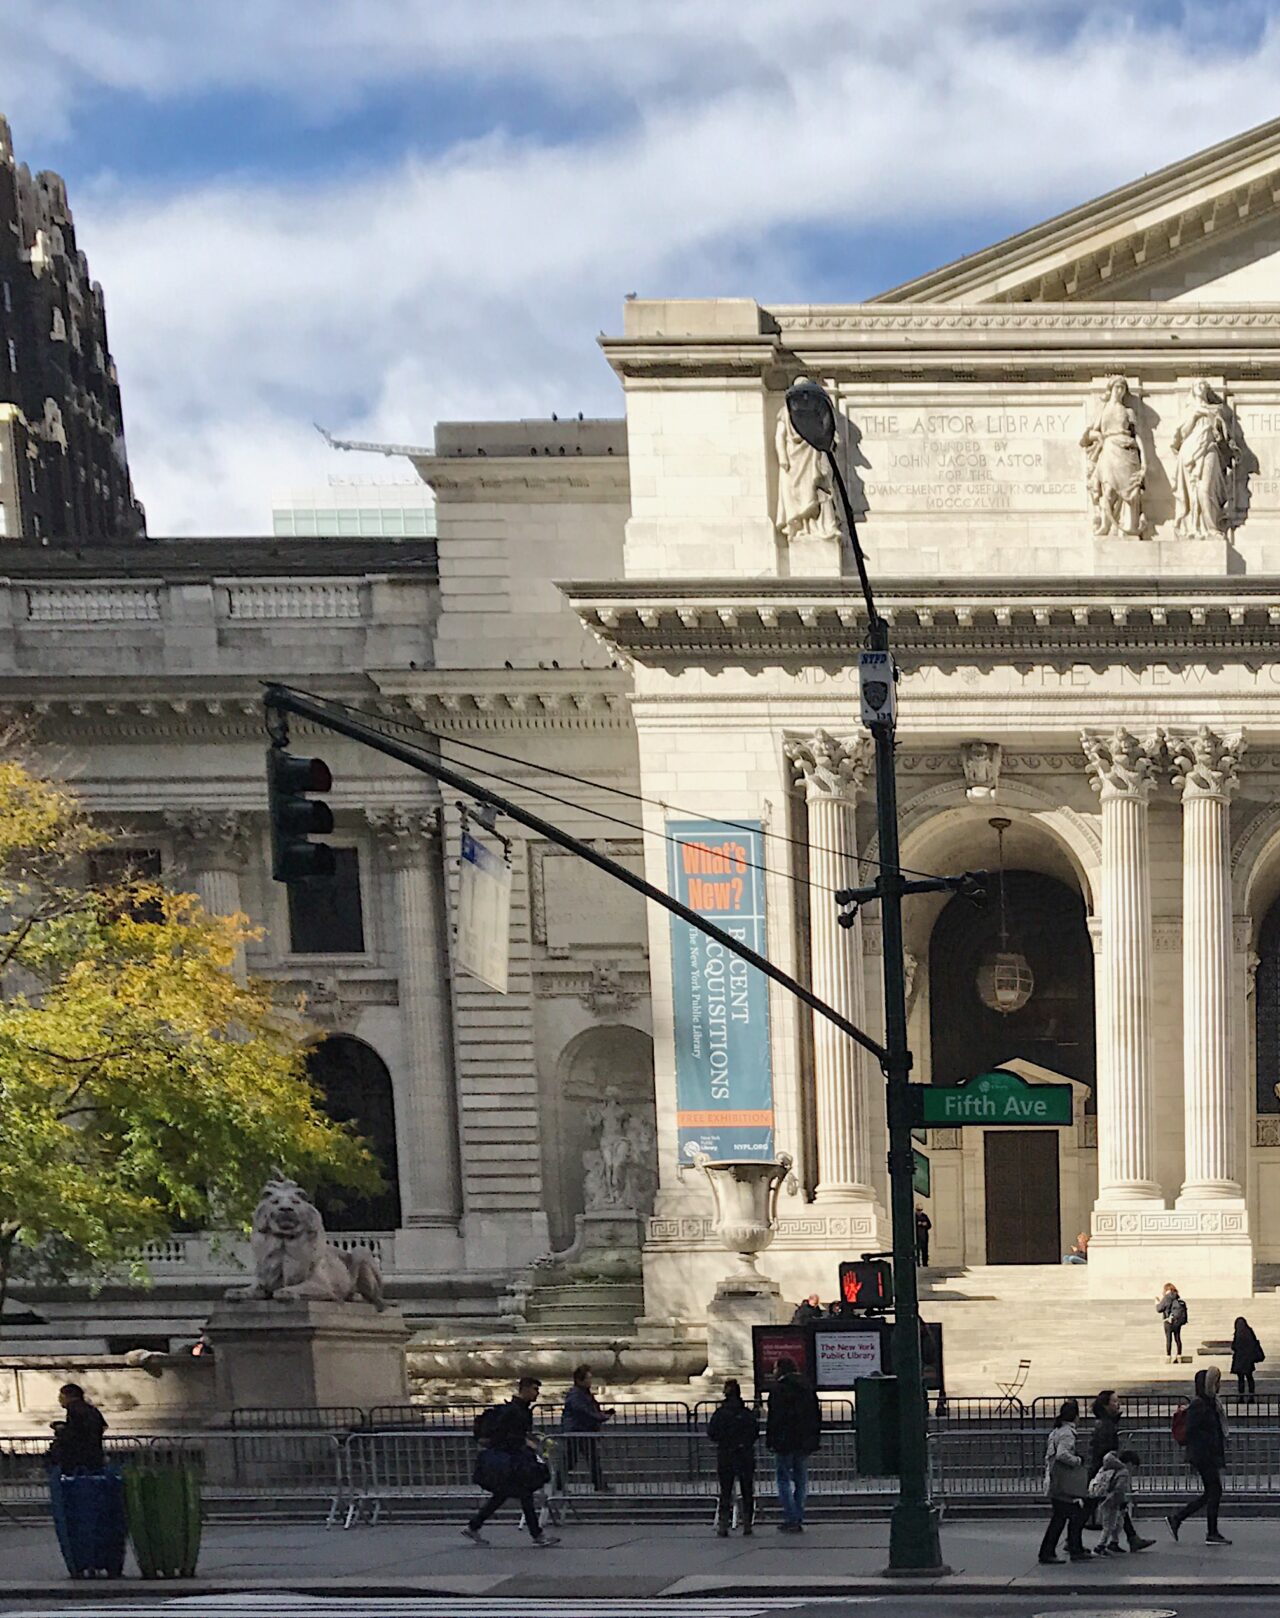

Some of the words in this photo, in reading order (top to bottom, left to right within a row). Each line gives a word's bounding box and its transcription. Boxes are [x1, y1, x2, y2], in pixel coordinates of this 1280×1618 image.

[861, 415, 899, 434] THE
[912, 415, 975, 434] ASTOR
[987, 415, 1071, 434] LIBRARY
[923, 441, 981, 452] FOUNDED
[994, 441, 1009, 452] BY
[890, 454, 931, 468] JOHN
[937, 454, 987, 468] JACOB
[996, 454, 1043, 468] ASTOR
[970, 470, 994, 481] THE
[946, 484, 962, 495] OF
[967, 483, 1006, 495] USEFUL
[1009, 483, 1078, 495] KNOWLEDGE
[861, 653, 888, 665] NYPD
[1013, 662, 1092, 687] THE
[1119, 662, 1212, 686] NEW
[682, 841, 747, 874] What's
[688, 877, 743, 911] New?
[688, 927, 699, 946] The
[689, 946, 700, 967] New
[690, 968, 702, 992] York
[727, 926, 750, 1025] RCENT
[691, 993, 702, 1023] Public
[703, 934, 731, 1100] CQUISITIONS
[691, 1023, 704, 1060] Library
[944, 1095, 996, 1117] Fifth
[1003, 1095, 1048, 1117] Ave
[681, 1112, 705, 1124] FREE
[707, 1112, 769, 1123] EXHIBITION
[733, 1143, 769, 1151] NYPL.ORG
[820, 1343, 836, 1351] The
[837, 1343, 856, 1351] New
[858, 1343, 875, 1351] York
[820, 1352, 845, 1360] Public
[847, 1351, 875, 1361] Library
